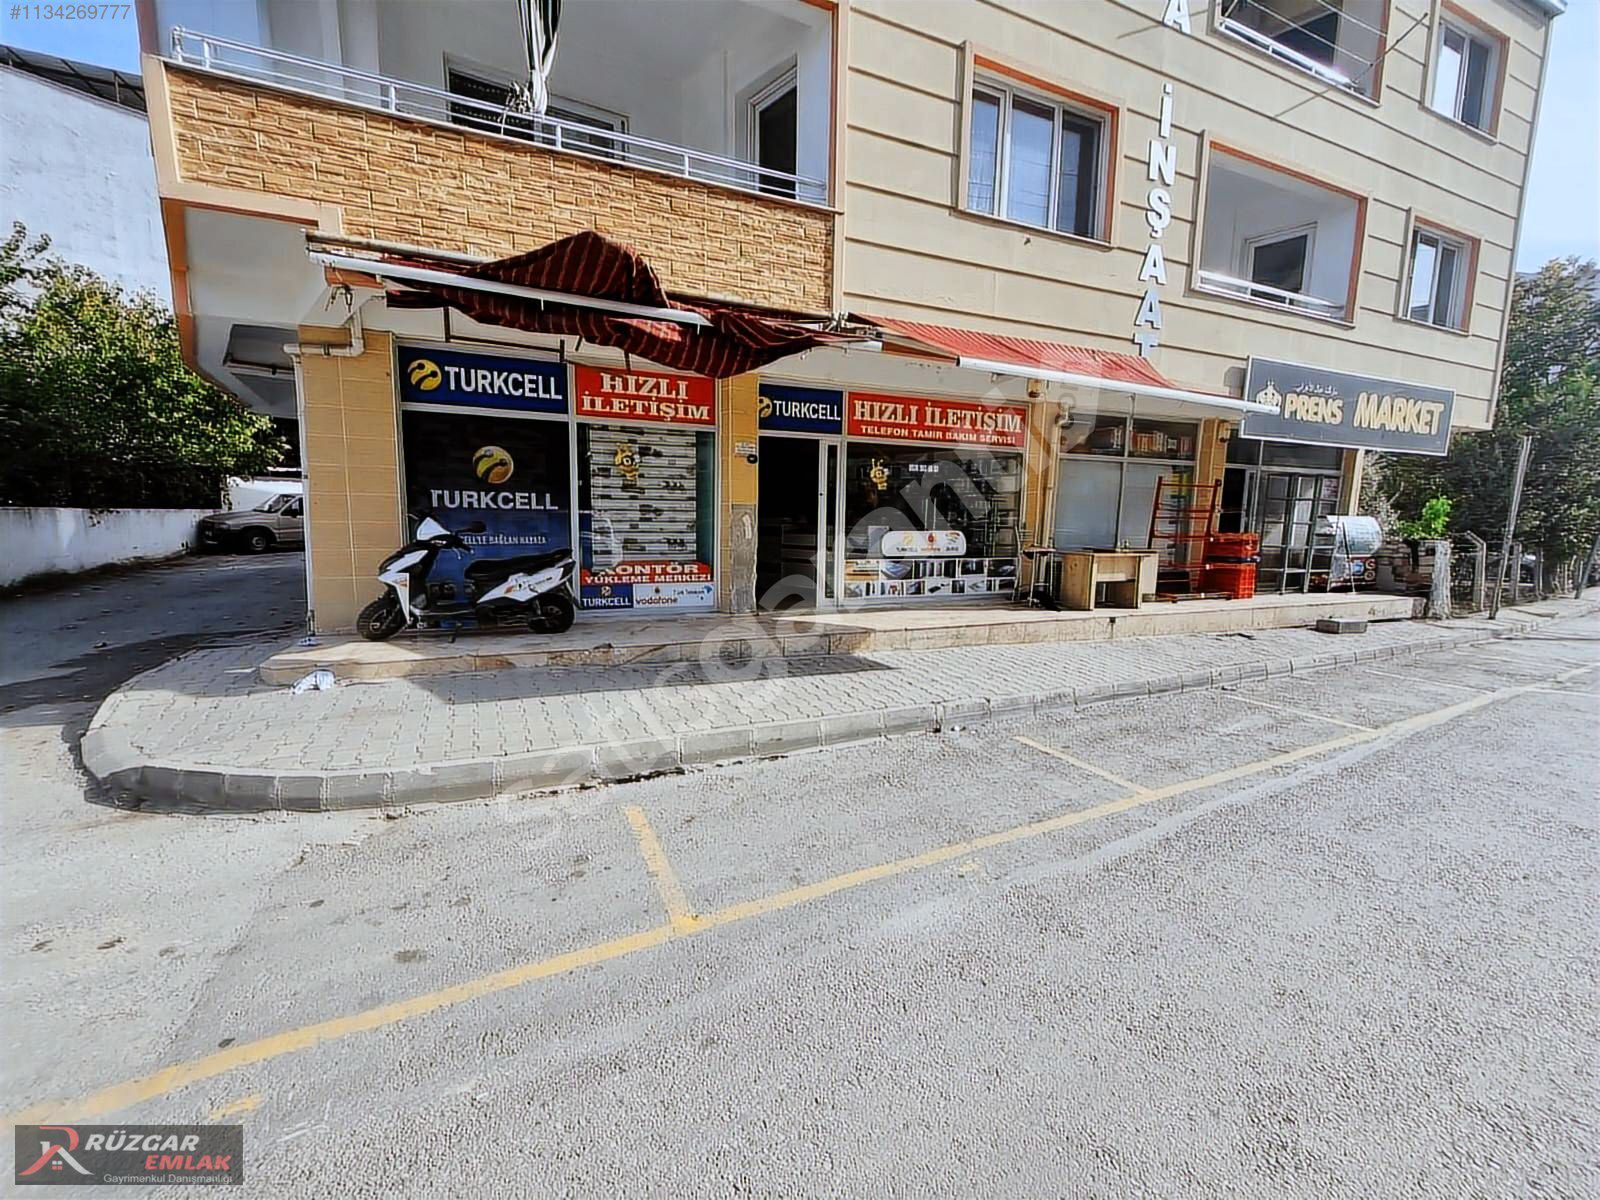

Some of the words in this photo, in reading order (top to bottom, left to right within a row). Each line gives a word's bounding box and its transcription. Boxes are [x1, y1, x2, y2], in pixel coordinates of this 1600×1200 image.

[444, 366, 563, 401] TURKCELL
[600, 372, 689, 400] HIZLI
[581, 391, 710, 423] İLETİŞİM
[773, 400, 841, 422] TURKCELL
[853, 399, 917, 425] HIZLI
[924, 401, 1023, 434] İLETİŞİM
[1284, 393, 1344, 425] PRENS
[1353, 391, 1445, 436] MARKET
[860, 424, 909, 439] TELEFON
[430, 489, 559, 510] TURKCELL
[583, 597, 632, 607] TURKCELL
